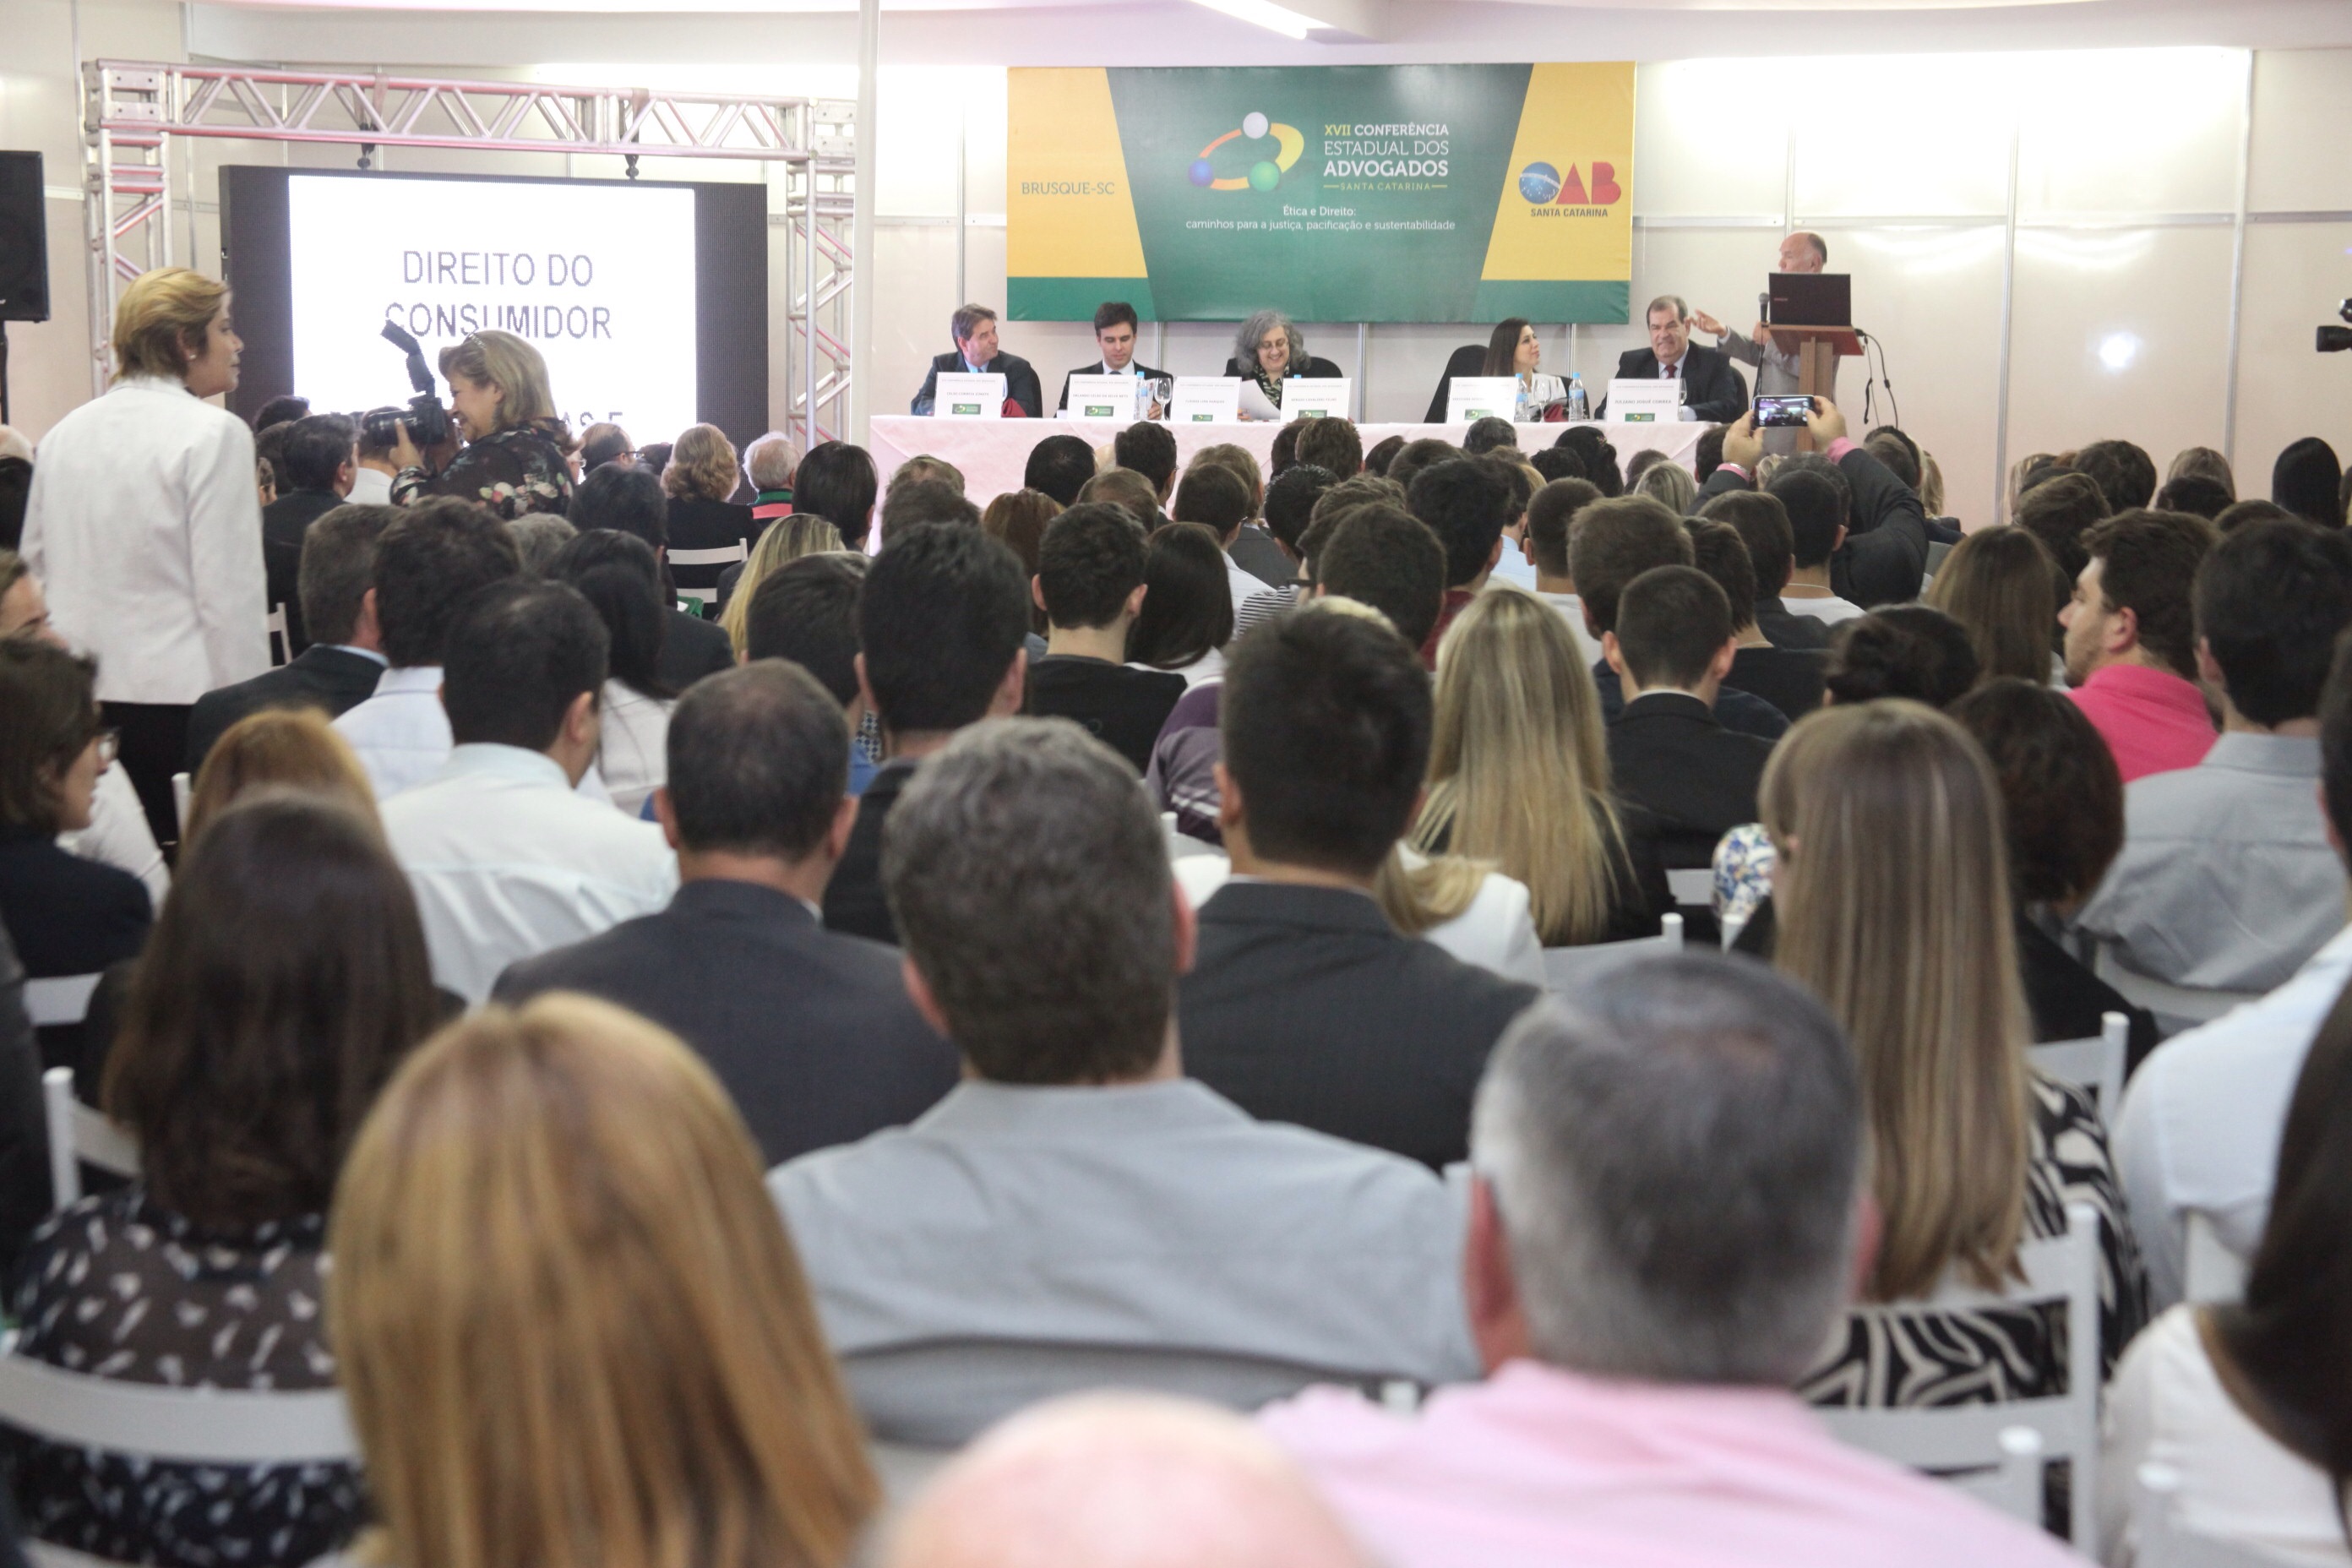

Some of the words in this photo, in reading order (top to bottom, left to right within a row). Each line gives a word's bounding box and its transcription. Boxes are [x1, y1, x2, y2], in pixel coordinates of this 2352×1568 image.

[1325, 124, 1351, 136] XVII
[1354, 122, 1449, 136] CONFERÊNCIA
[1324, 140, 1408, 156] ESTADUAL
[1414, 140, 1449, 156] DOS
[1323, 160, 1449, 177] ADVOGADOS
[1021, 182, 1115, 195] BRUSQUE-SC
[1340, 182, 1375, 191] SANTA
[1377, 182, 1431, 191] CATARINA
[1519, 161, 1621, 204] OAB
[1282, 204, 1308, 216] Ética
[1310, 207, 1316, 216] e
[1320, 205, 1357, 216] Direito:
[1531, 208, 1560, 217] SANTA
[1563, 208, 1609, 217] CATARINA
[1185, 219, 1234, 230] caminhos
[1237, 220, 1258, 231] para
[1260, 221, 1266, 230] a
[1269, 220, 1304, 231] justiça,
[1306, 219, 1363, 231] pacificação
[1374, 220, 1456, 231] sustentabilidade
[403, 250, 535, 286] DIREITO
[548, 253, 593, 287] DO
[385, 302, 612, 339] CONSUMIDOR
